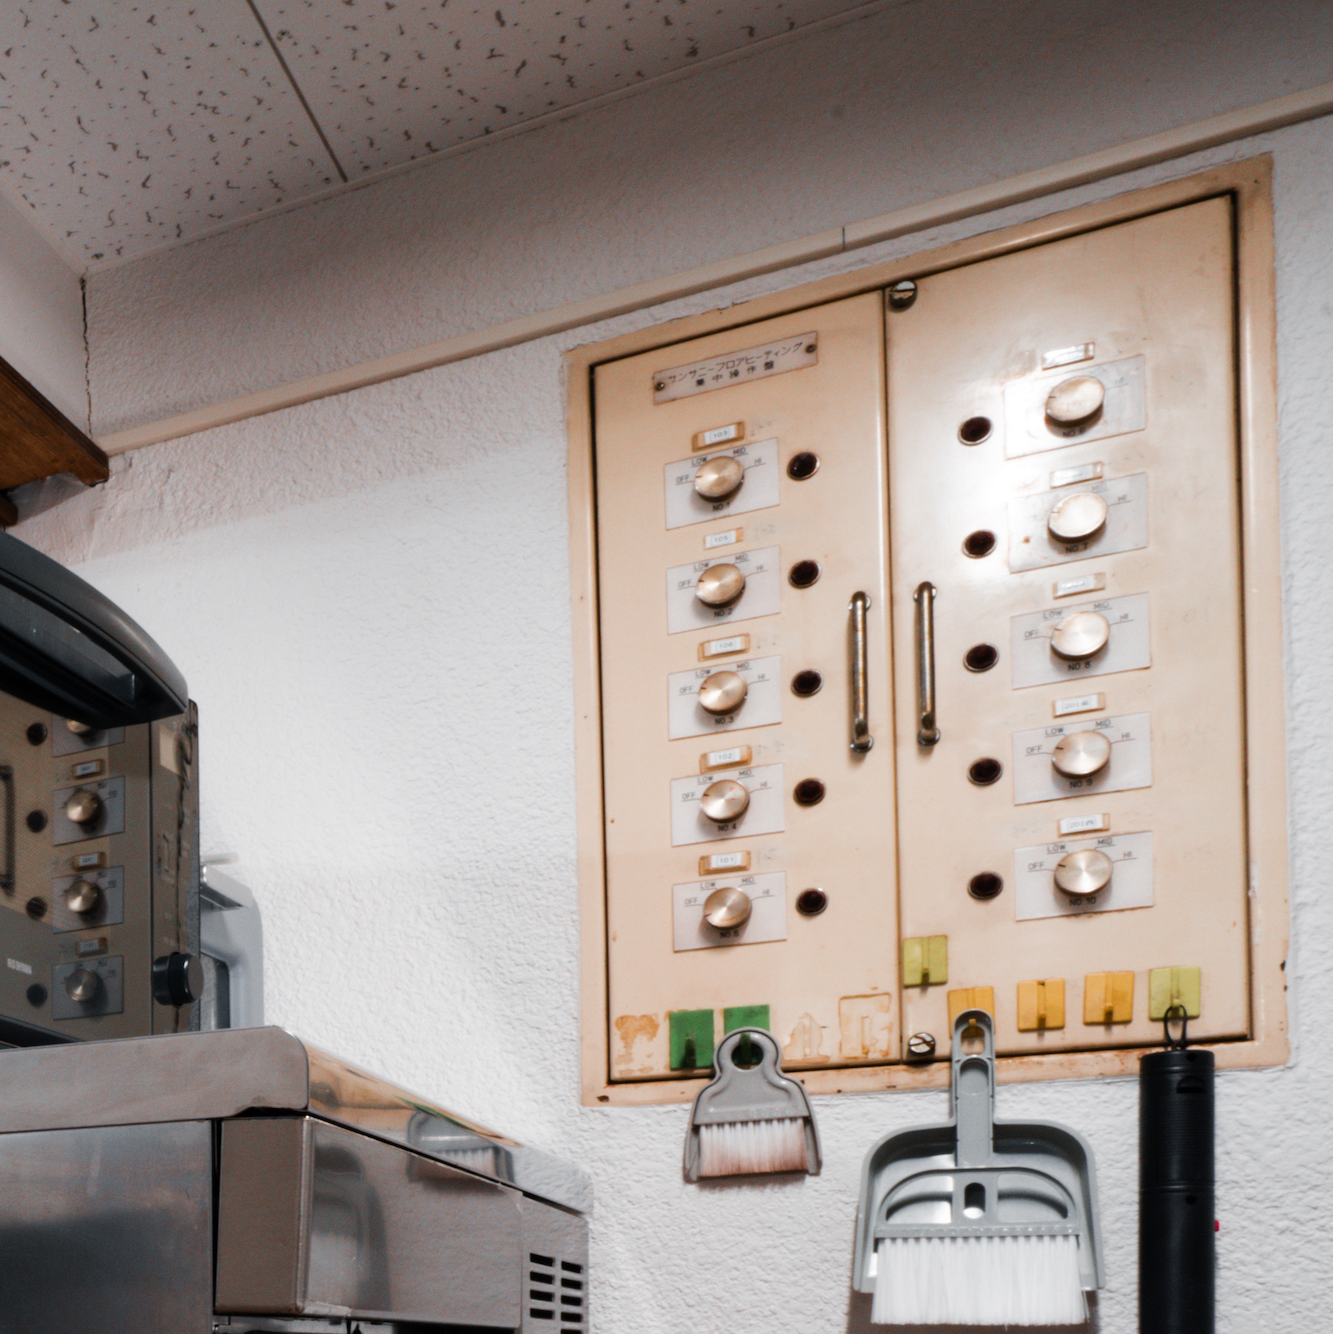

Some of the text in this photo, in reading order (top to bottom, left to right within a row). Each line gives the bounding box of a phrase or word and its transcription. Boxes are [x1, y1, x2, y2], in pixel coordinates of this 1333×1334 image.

[692, 457, 707, 466] LOW
[676, 474, 689, 484] OFF
[694, 562, 710, 571] LOW
[678, 580, 692, 588] OFF
[1043, 609, 1063, 619] LOW
[1024, 629, 1040, 638] OFF
[695, 669, 711, 677] LOW
[679, 686, 693, 694] OFF
[1045, 727, 1064, 735] LOW
[1026, 745, 1043, 754] OFF
[698, 775, 713, 783] LOW
[681, 791, 695, 799] OFF
[1047, 844, 1066, 852] LOW
[1028, 862, 1045, 870] OFF
[684, 897, 698, 905] OFF
